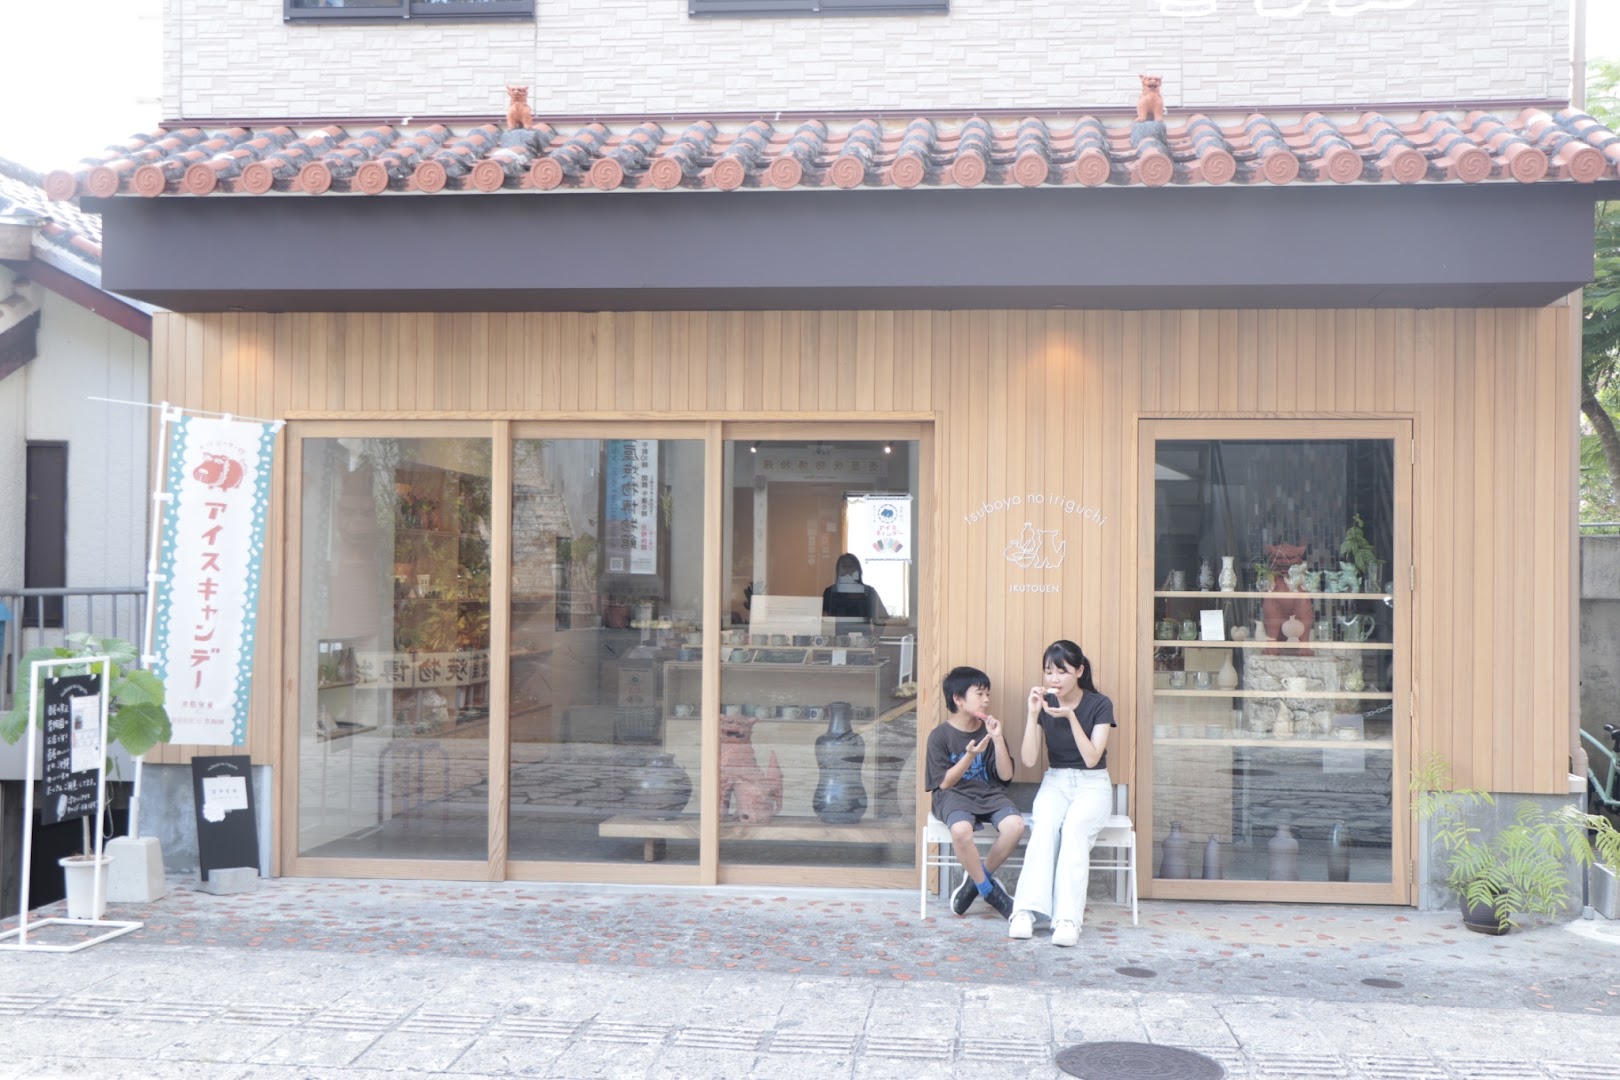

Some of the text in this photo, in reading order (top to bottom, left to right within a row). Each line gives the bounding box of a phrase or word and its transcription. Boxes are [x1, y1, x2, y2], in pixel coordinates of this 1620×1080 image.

[963, 493, 1108, 526] tsuboya no iriguchi
[190, 502, 228, 689] アイスキャンデー
[1009, 584, 1060, 593] IKUTOUEN
